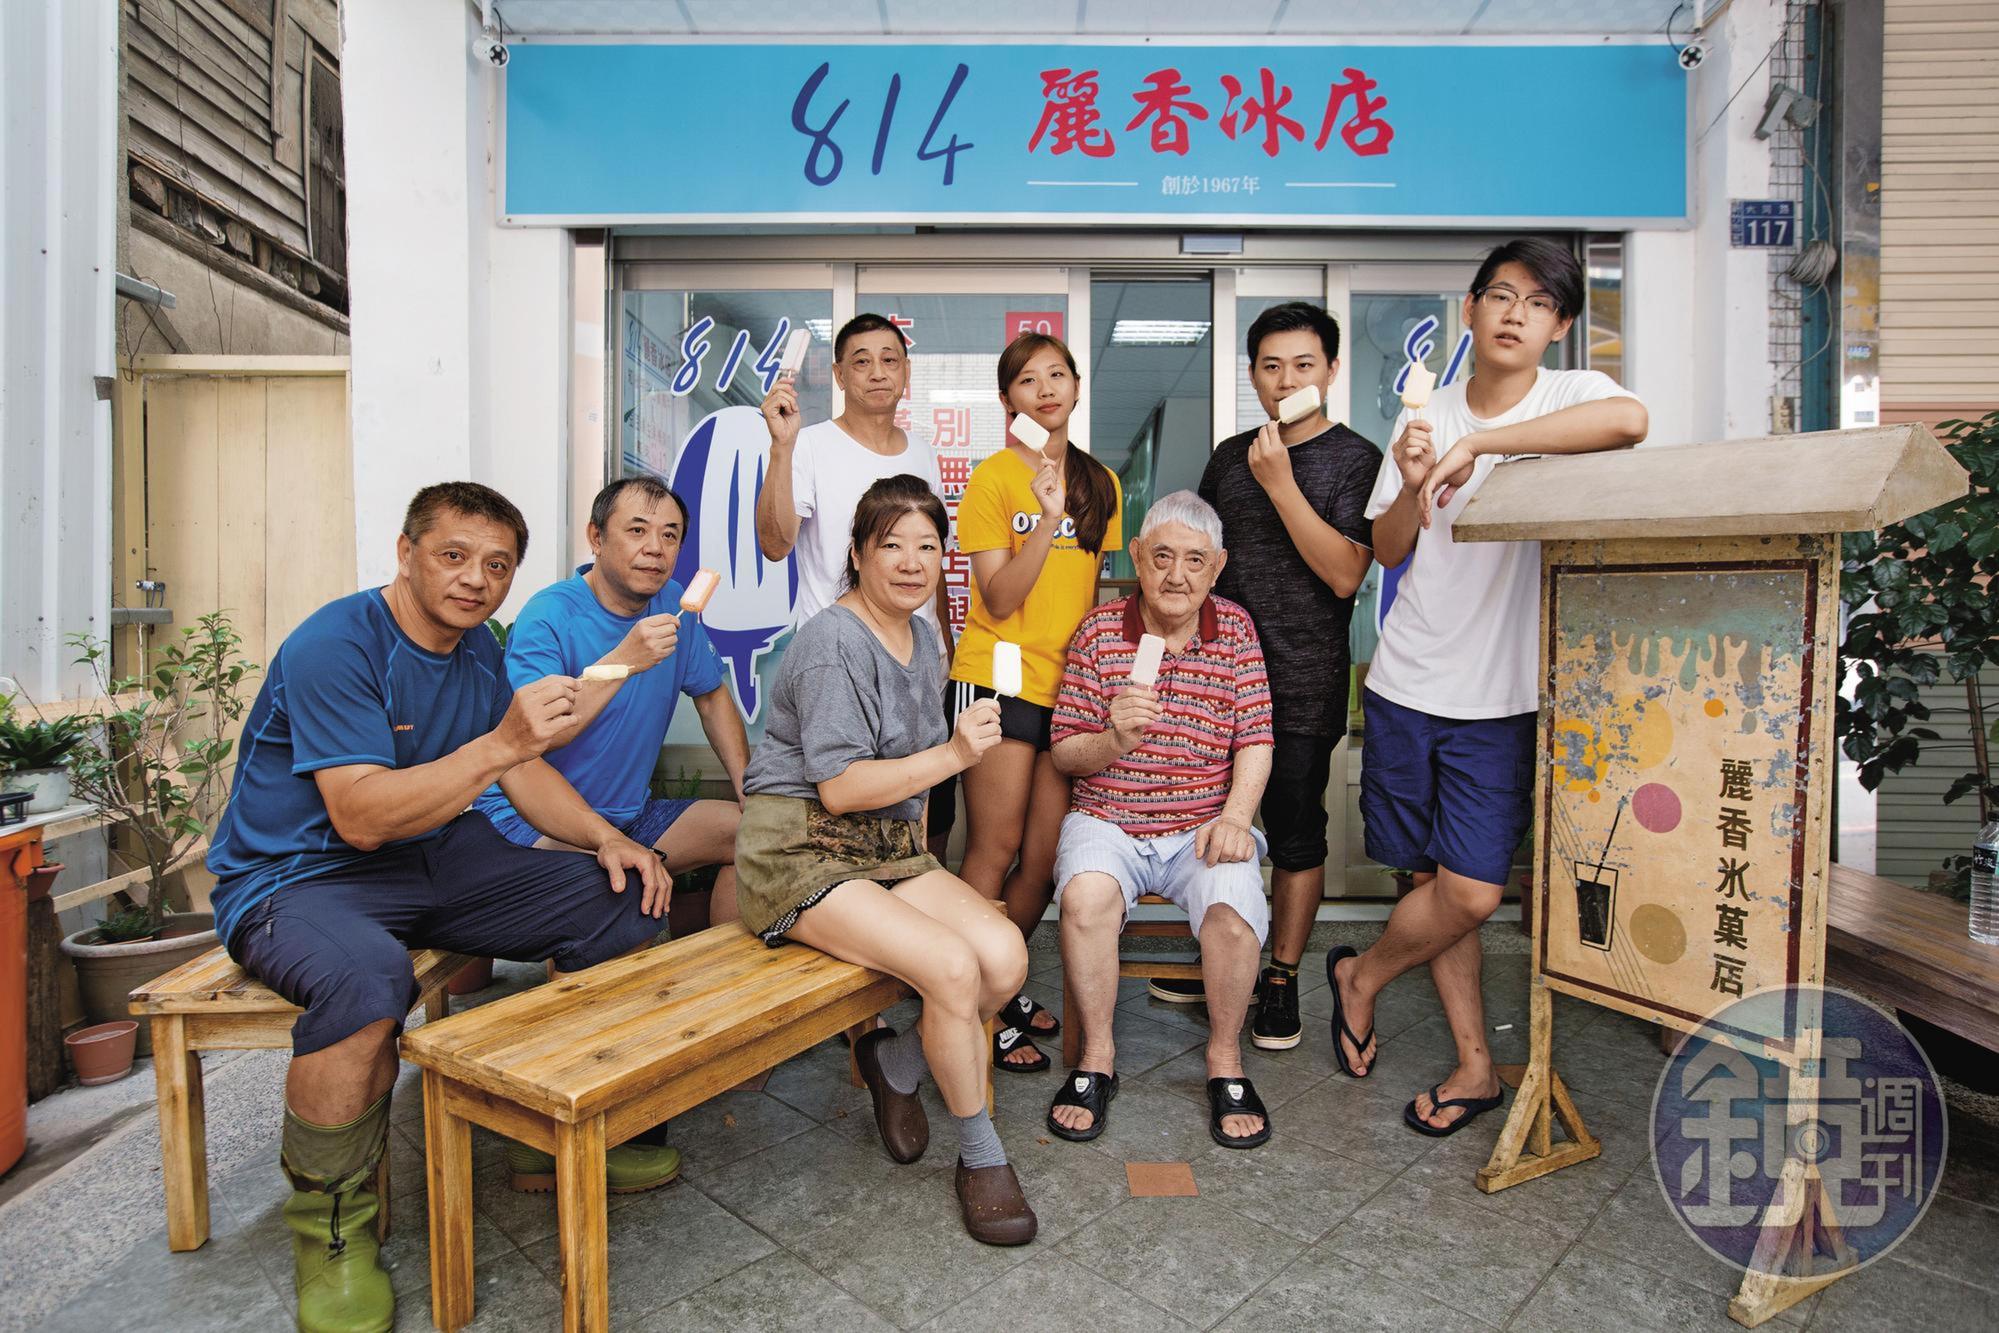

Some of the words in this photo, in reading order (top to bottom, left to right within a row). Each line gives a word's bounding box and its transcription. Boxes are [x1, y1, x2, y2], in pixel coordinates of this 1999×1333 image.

[791, 61, 974, 187] 814
[1027, 67, 1395, 158] 麗香冰店
[1161, 175, 1261, 196] 創於1967年
[1747, 220, 1787, 245] 117
[671, 316, 790, 397] 814
